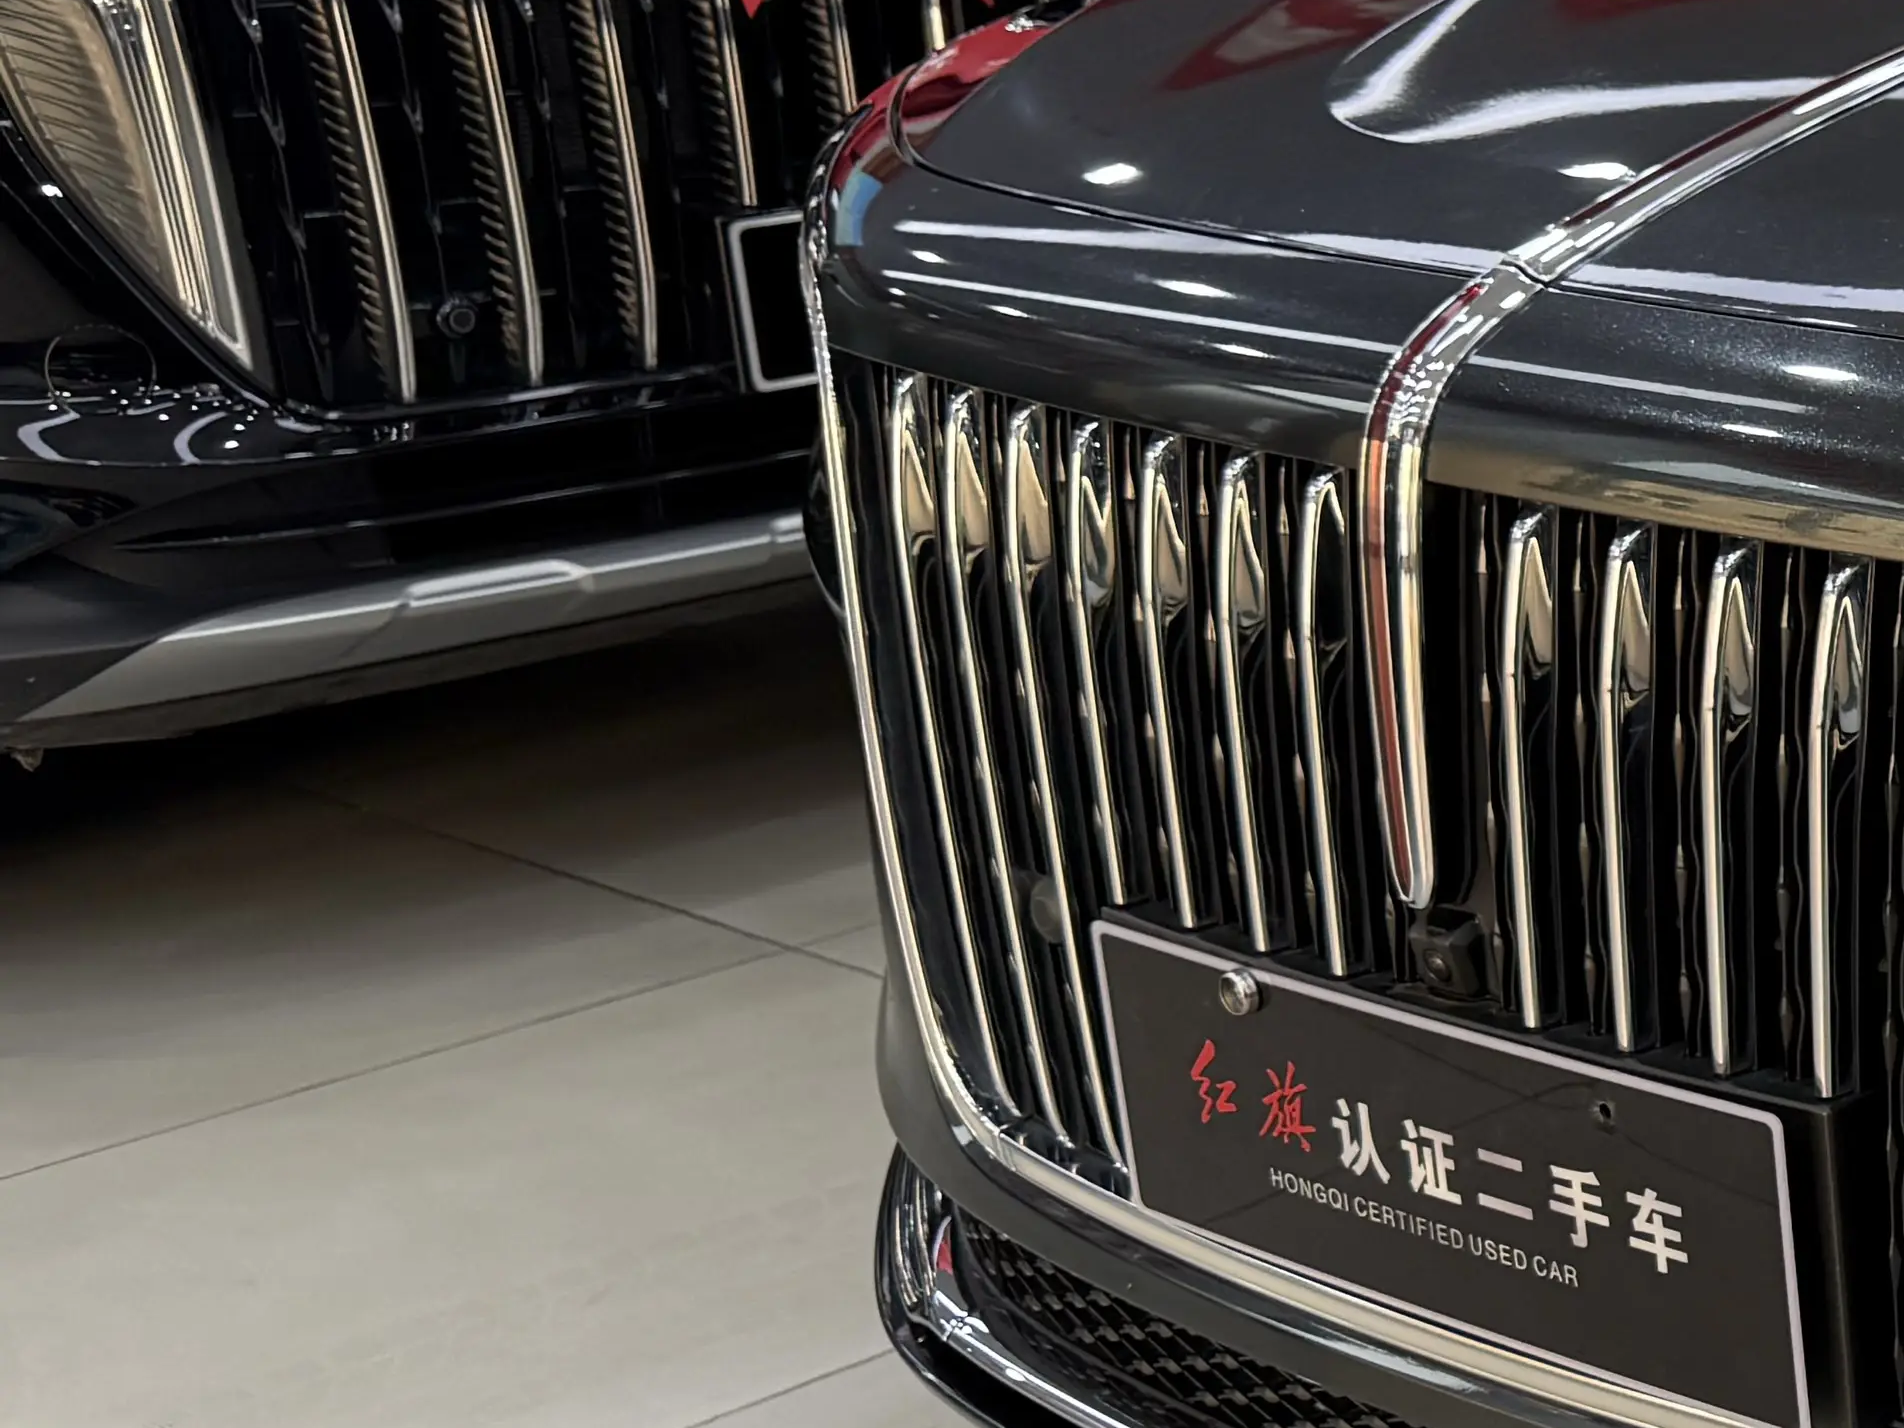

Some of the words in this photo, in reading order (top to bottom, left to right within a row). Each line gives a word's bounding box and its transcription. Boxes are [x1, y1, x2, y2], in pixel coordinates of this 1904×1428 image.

[1269, 1166, 1350, 1214] HONGQI
[1353, 1196, 1464, 1251] CERTIFIED
[1468, 1233, 1528, 1271] USED
[1533, 1253, 1580, 1288] CAR
